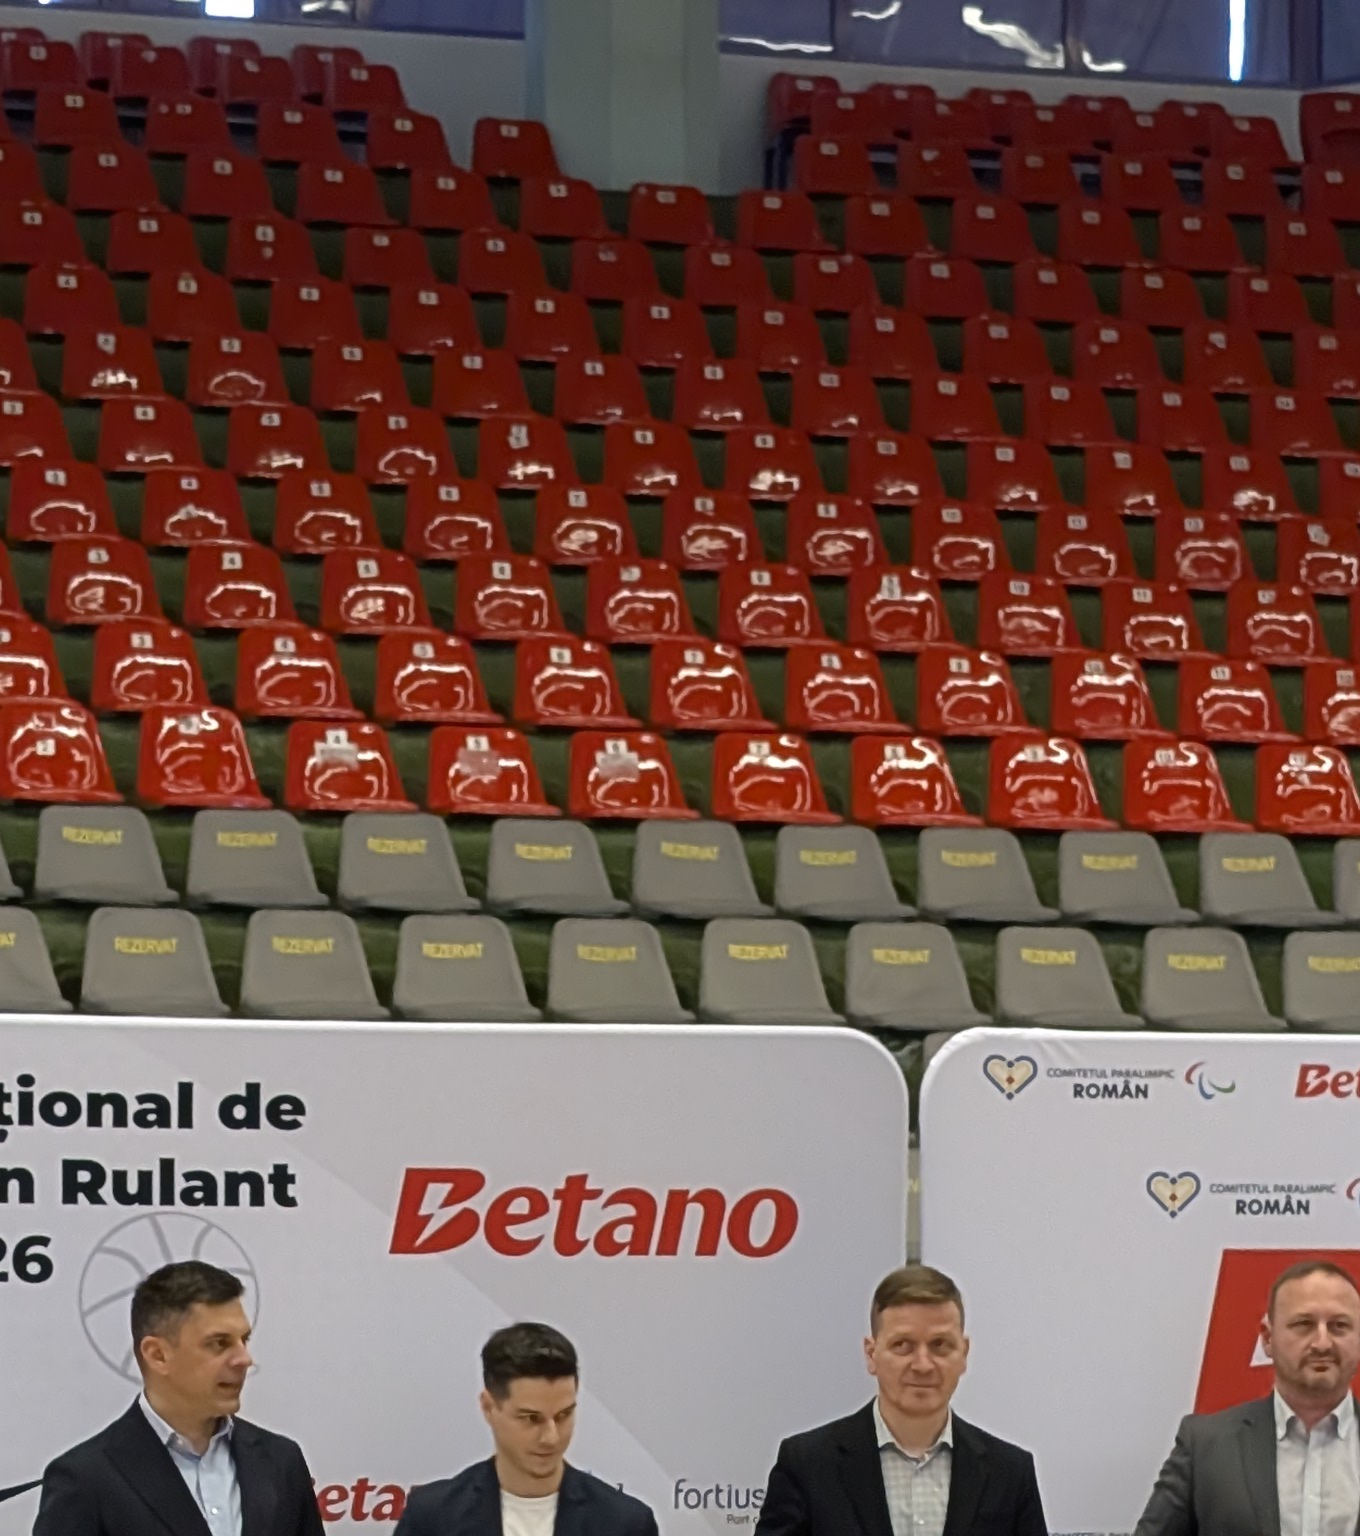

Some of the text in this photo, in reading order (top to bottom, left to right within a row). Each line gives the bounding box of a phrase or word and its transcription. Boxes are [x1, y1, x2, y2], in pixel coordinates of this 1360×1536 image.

[218, 1082, 306, 1130] de
[1073, 1077, 1148, 1099] ROMÂN
[62, 1158, 298, 1207] Rulant
[1236, 1192, 1310, 1215] ROMÂN
[389, 1168, 798, 1257] Betano
[319, 1477, 405, 1521] eta
[674, 1478, 766, 1509] fortius
